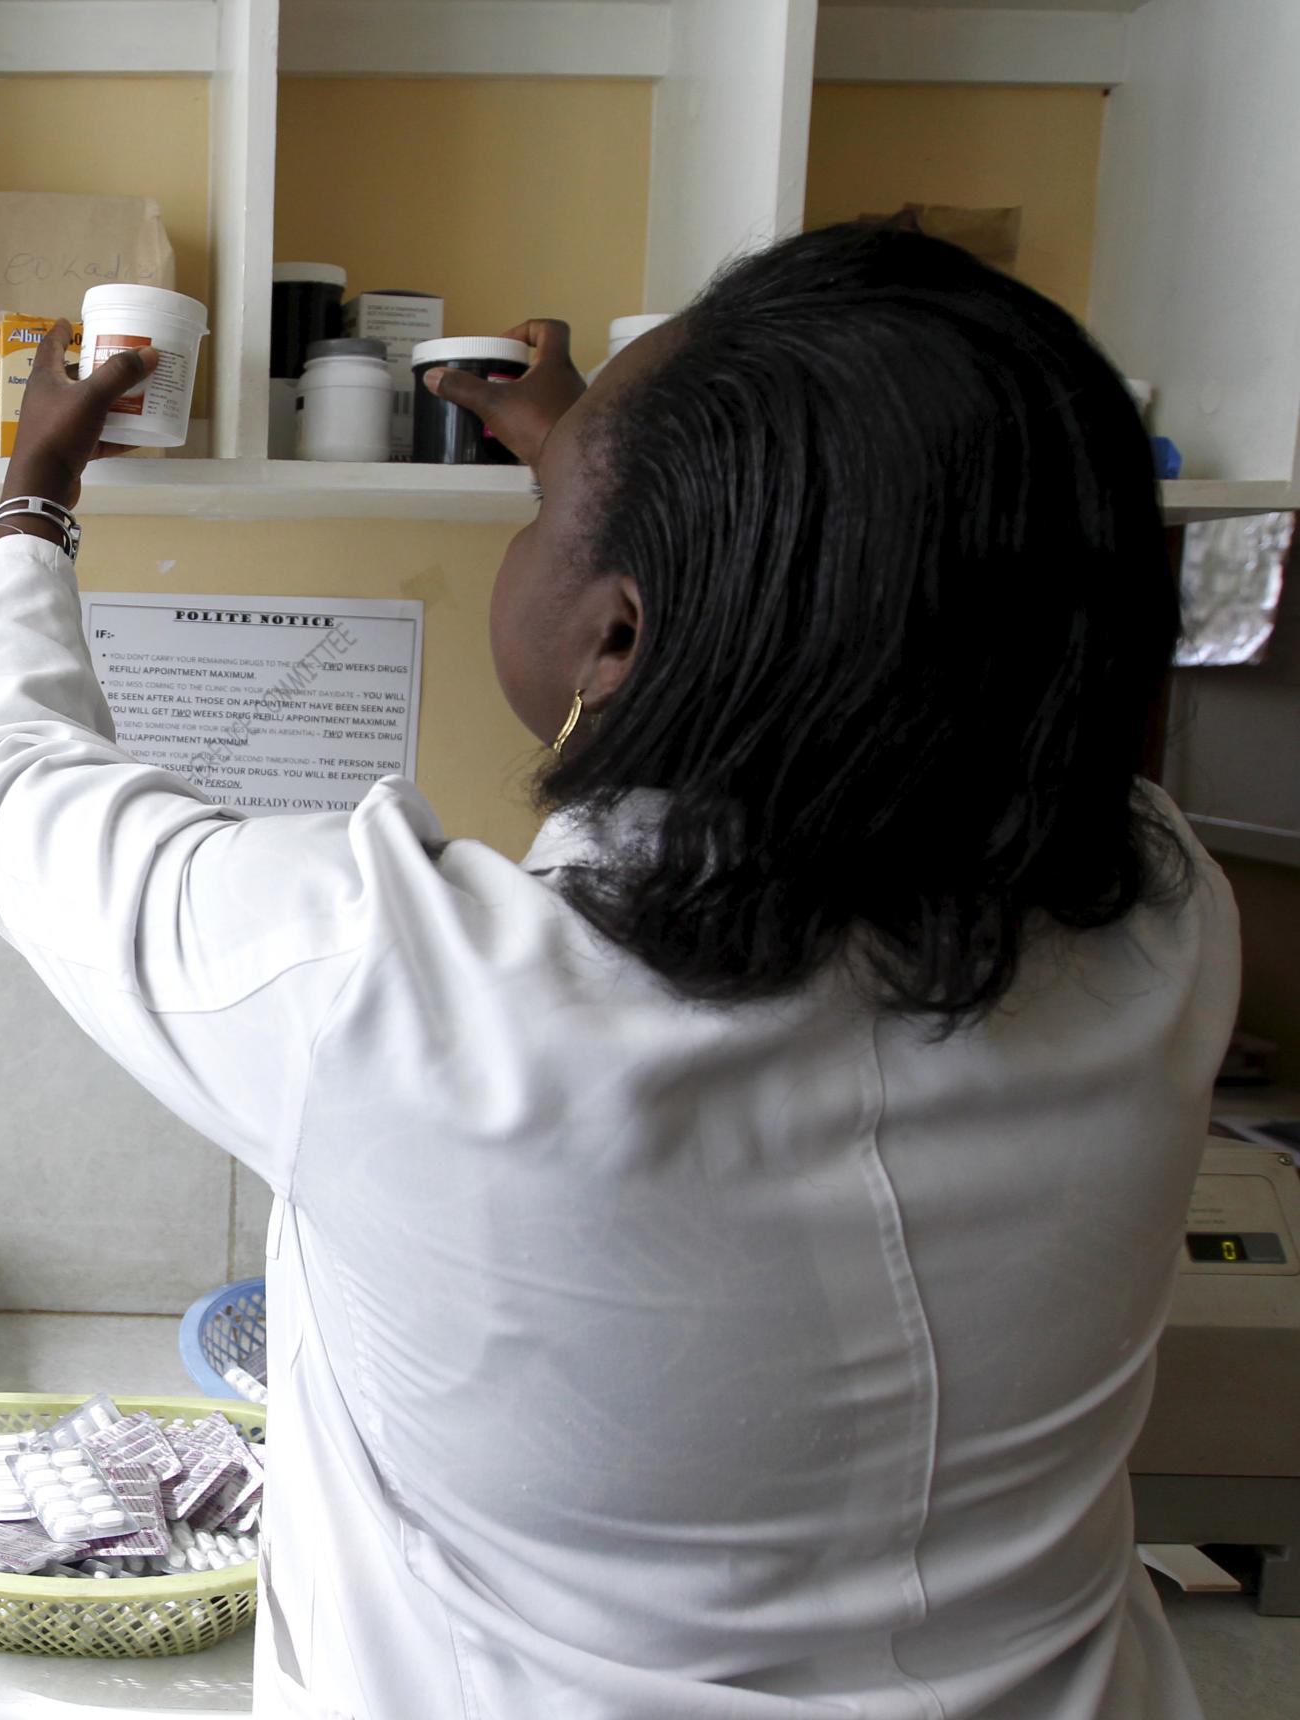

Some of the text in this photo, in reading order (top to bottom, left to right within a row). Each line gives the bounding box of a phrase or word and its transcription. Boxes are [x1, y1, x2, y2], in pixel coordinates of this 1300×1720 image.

[8, 328, 44, 344] Albu
[8, 376, 28, 385] Alben
[174, 610, 335, 627] POLITE NOTICE
[95, 630, 115, 638] IF:-
[110, 652, 126, 660] YOU
[127, 653, 150, 661] DON'T
[151, 654, 174, 662] CARRY
[198, 656, 238, 666] REMAINING
[239, 658, 264, 667] DRUGS
[322, 662, 343, 672] TWO
[345, 663, 376, 672] WEEKS
[378, 664, 408, 674] DRUGS
[109, 665, 257, 680] REFILL/ APPOINTMENT MAXIMUM.
[126, 680, 143, 688] MISS
[145, 682, 174, 690] COMING
[176, 682, 187, 690] TO
[363, 691, 382, 700] YOU
[384, 692, 406, 701] WILL
[108, 692, 406, 714] BE SEEN AFTER ALL THOSE ON APPOINTMENT HAVE BEEN SEEN AND
[128, 706, 150, 714] WILL
[152, 707, 168, 716] GET
[170, 708, 192, 718] TWO
[193, 710, 224, 718] WEEKS
[226, 711, 250, 720] DRUG
[286, 714, 351, 724] APPOINTMENT
[116, 732, 202, 743] FILL/APPOINTMENT
[198, 724, 218, 732] YOUR
[323, 730, 343, 739] TWO
[345, 731, 376, 740] WEEKS
[378, 732, 402, 741] DRUG
[319, 758, 336, 766] THE
[338, 759, 374, 768] PERSON
[377, 760, 402, 769] SEND
[195, 765, 218, 774] WITH
[221, 766, 246, 775] YOUR
[284, 770, 302, 778] YOU
[305, 770, 325, 779] WILL
[328, 772, 338, 780] BE
[341, 772, 384, 781] EXPECTE
[204, 778, 243, 789] PERSON.
[210, 794, 230, 805] OU
[234, 795, 290, 808] ALREADY
[292, 799, 324, 810] OWN
